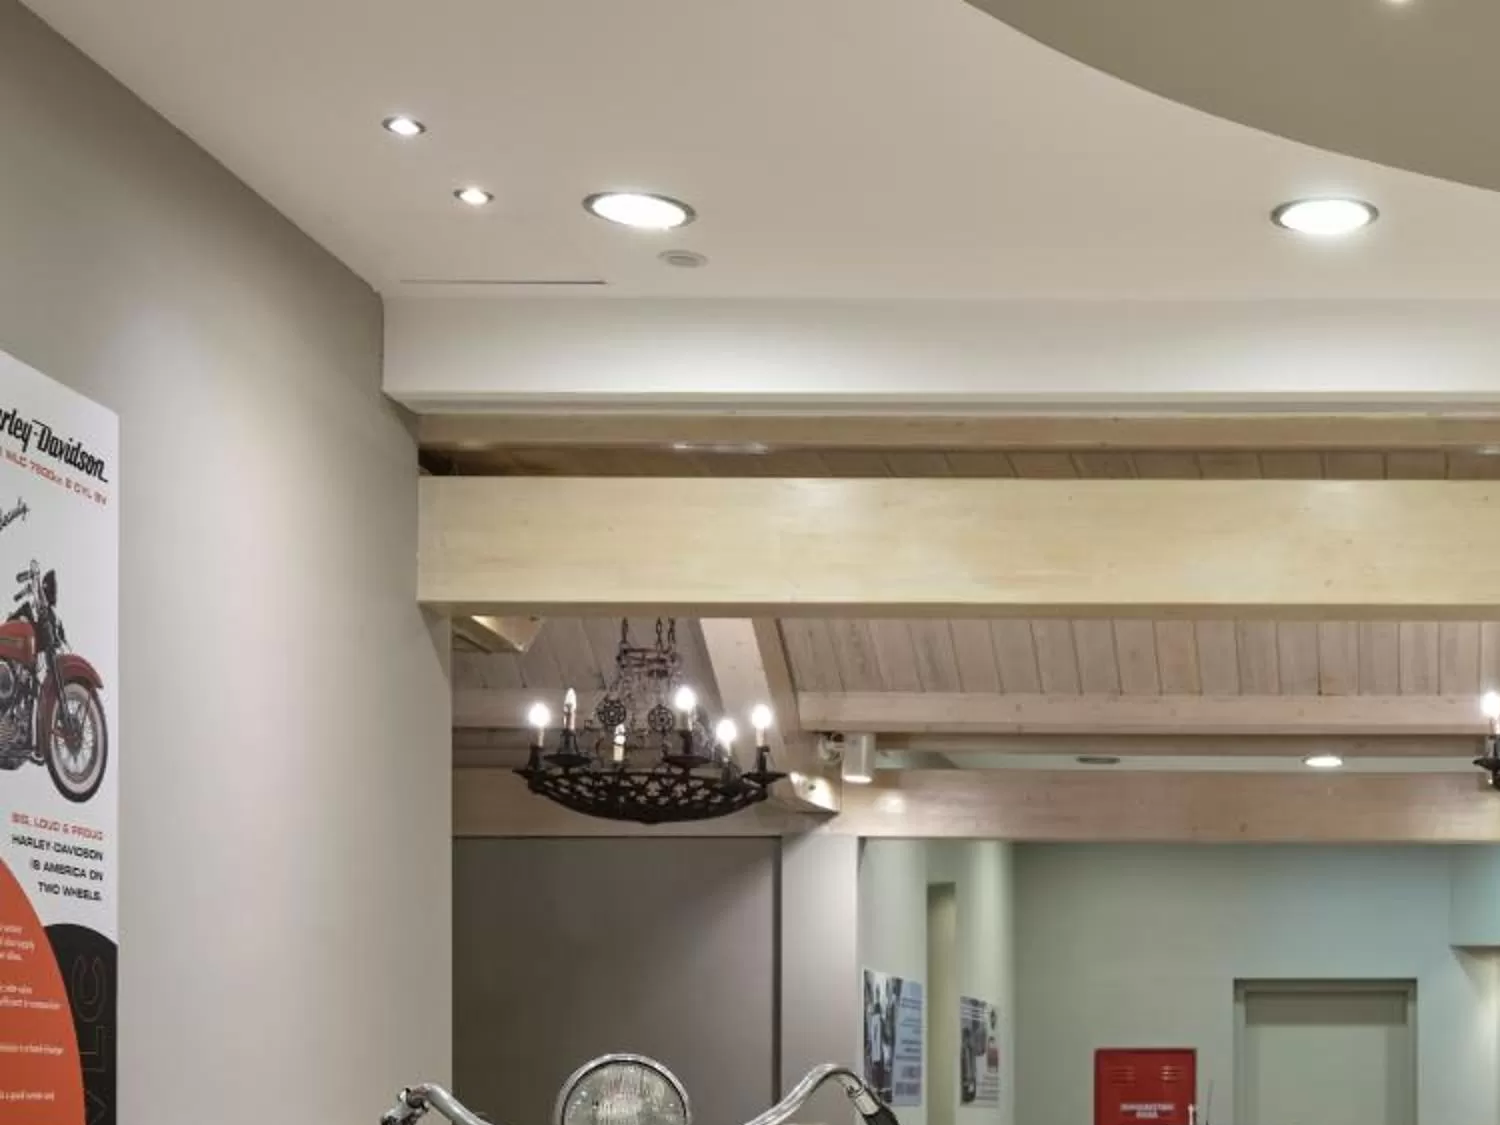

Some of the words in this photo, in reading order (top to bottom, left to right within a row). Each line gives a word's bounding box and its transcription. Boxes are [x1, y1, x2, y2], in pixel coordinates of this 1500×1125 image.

[12, 835, 103, 861] HARLEY-DAVIDSON
[43, 861, 87, 879] AMERICA
[89, 870, 104, 881] ON
[38, 882, 61, 895] TWO
